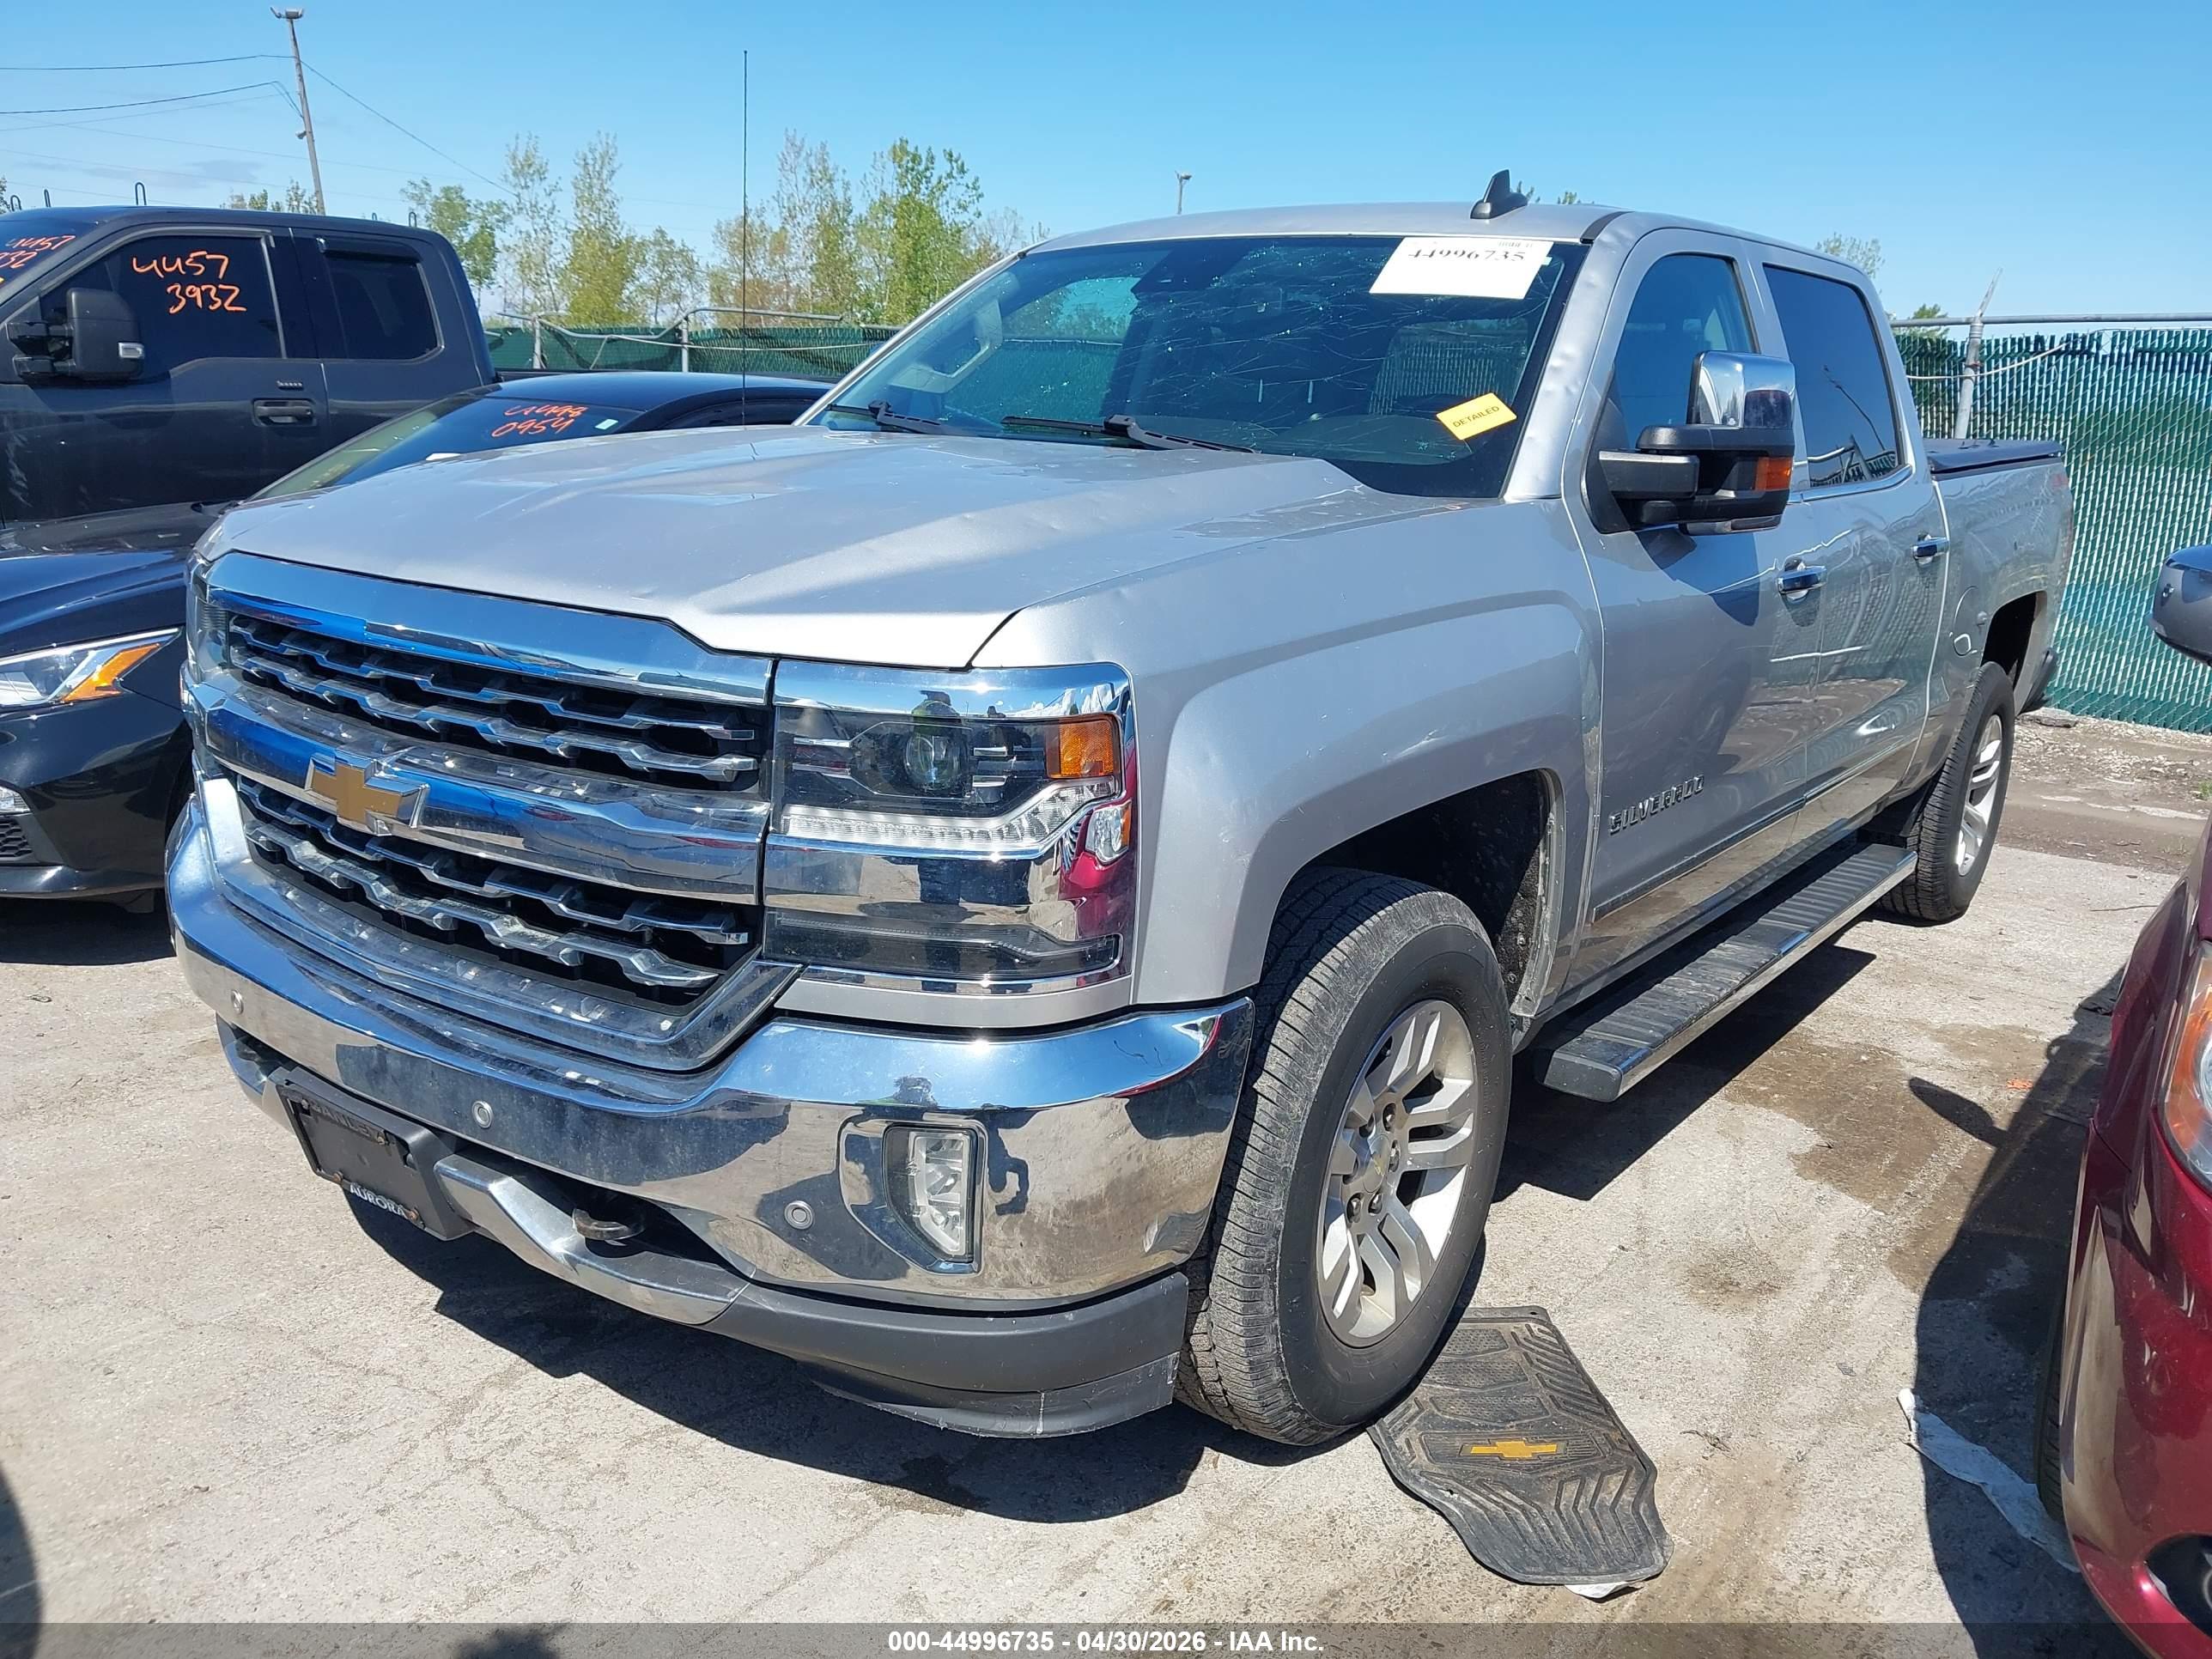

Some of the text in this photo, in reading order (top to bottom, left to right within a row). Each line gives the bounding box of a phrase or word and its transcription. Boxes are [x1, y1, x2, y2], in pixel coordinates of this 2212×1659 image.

[4, 234, 76, 252] 4457
[1407, 248, 1526, 261] 44996735
[131, 250, 230, 280] 4457
[165, 282, 248, 314] 3932
[490, 416, 575, 439] 0954
[1452, 404, 1500, 428] DETAILED
[1608, 775, 1705, 836] SILVERADO
[349, 1182, 409, 1220] AURORA
